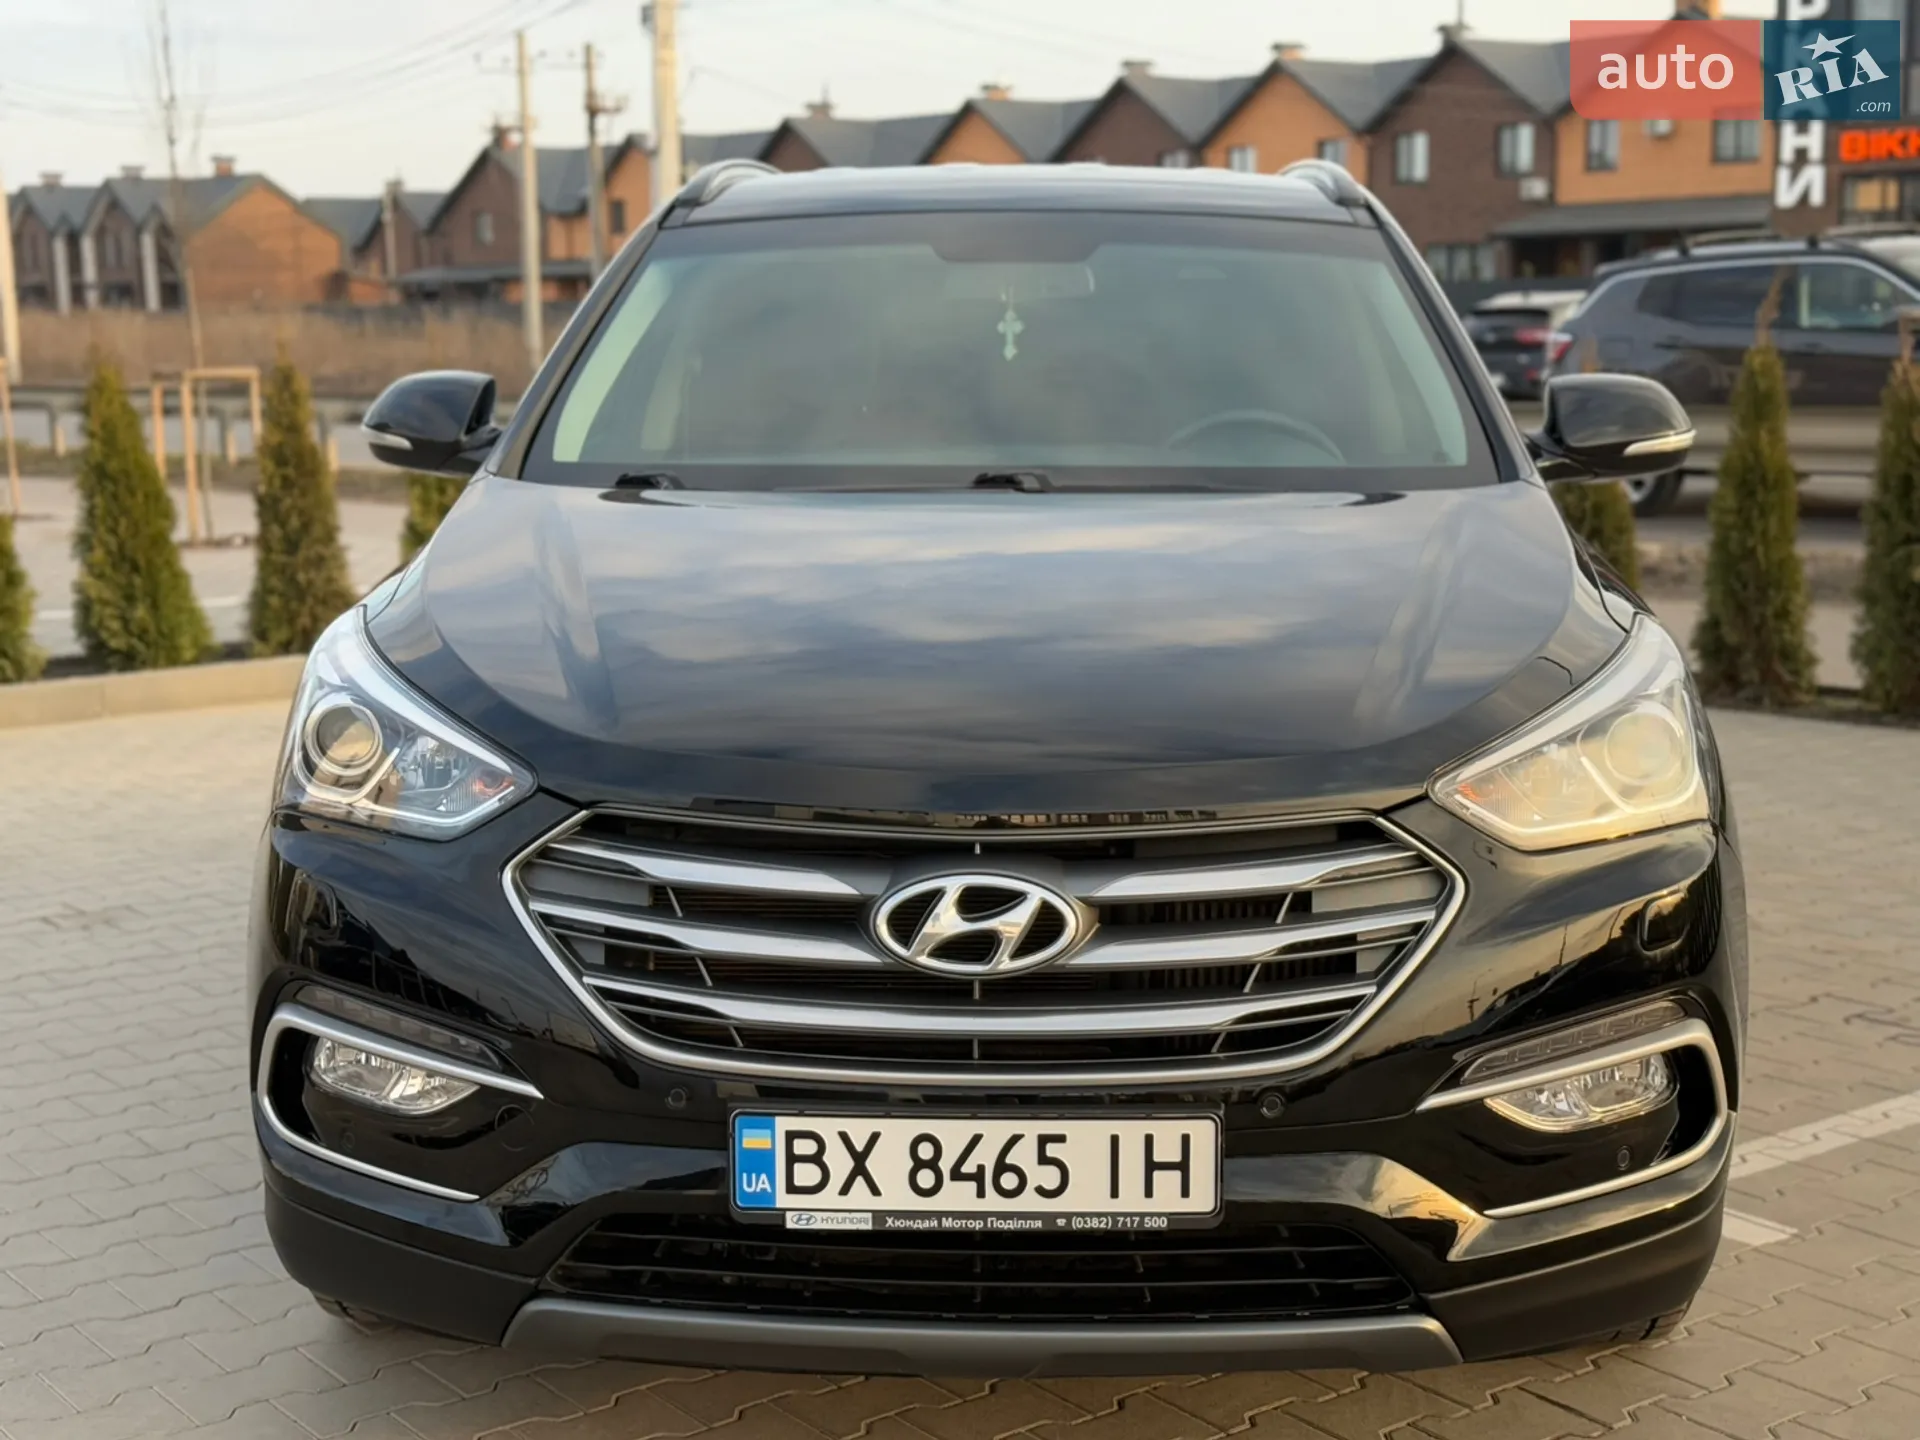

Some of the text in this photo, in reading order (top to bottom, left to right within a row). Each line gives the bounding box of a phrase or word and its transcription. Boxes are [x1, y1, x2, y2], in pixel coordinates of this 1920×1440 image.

[785, 1130, 1191, 1199] BX 8465 IH
[742, 1172, 772, 1193] UA
[820, 1216, 870, 1226] HYUNDAI
[885, 1216, 1168, 1229] Хюндай Мотор Поділля (0382) 717 500
